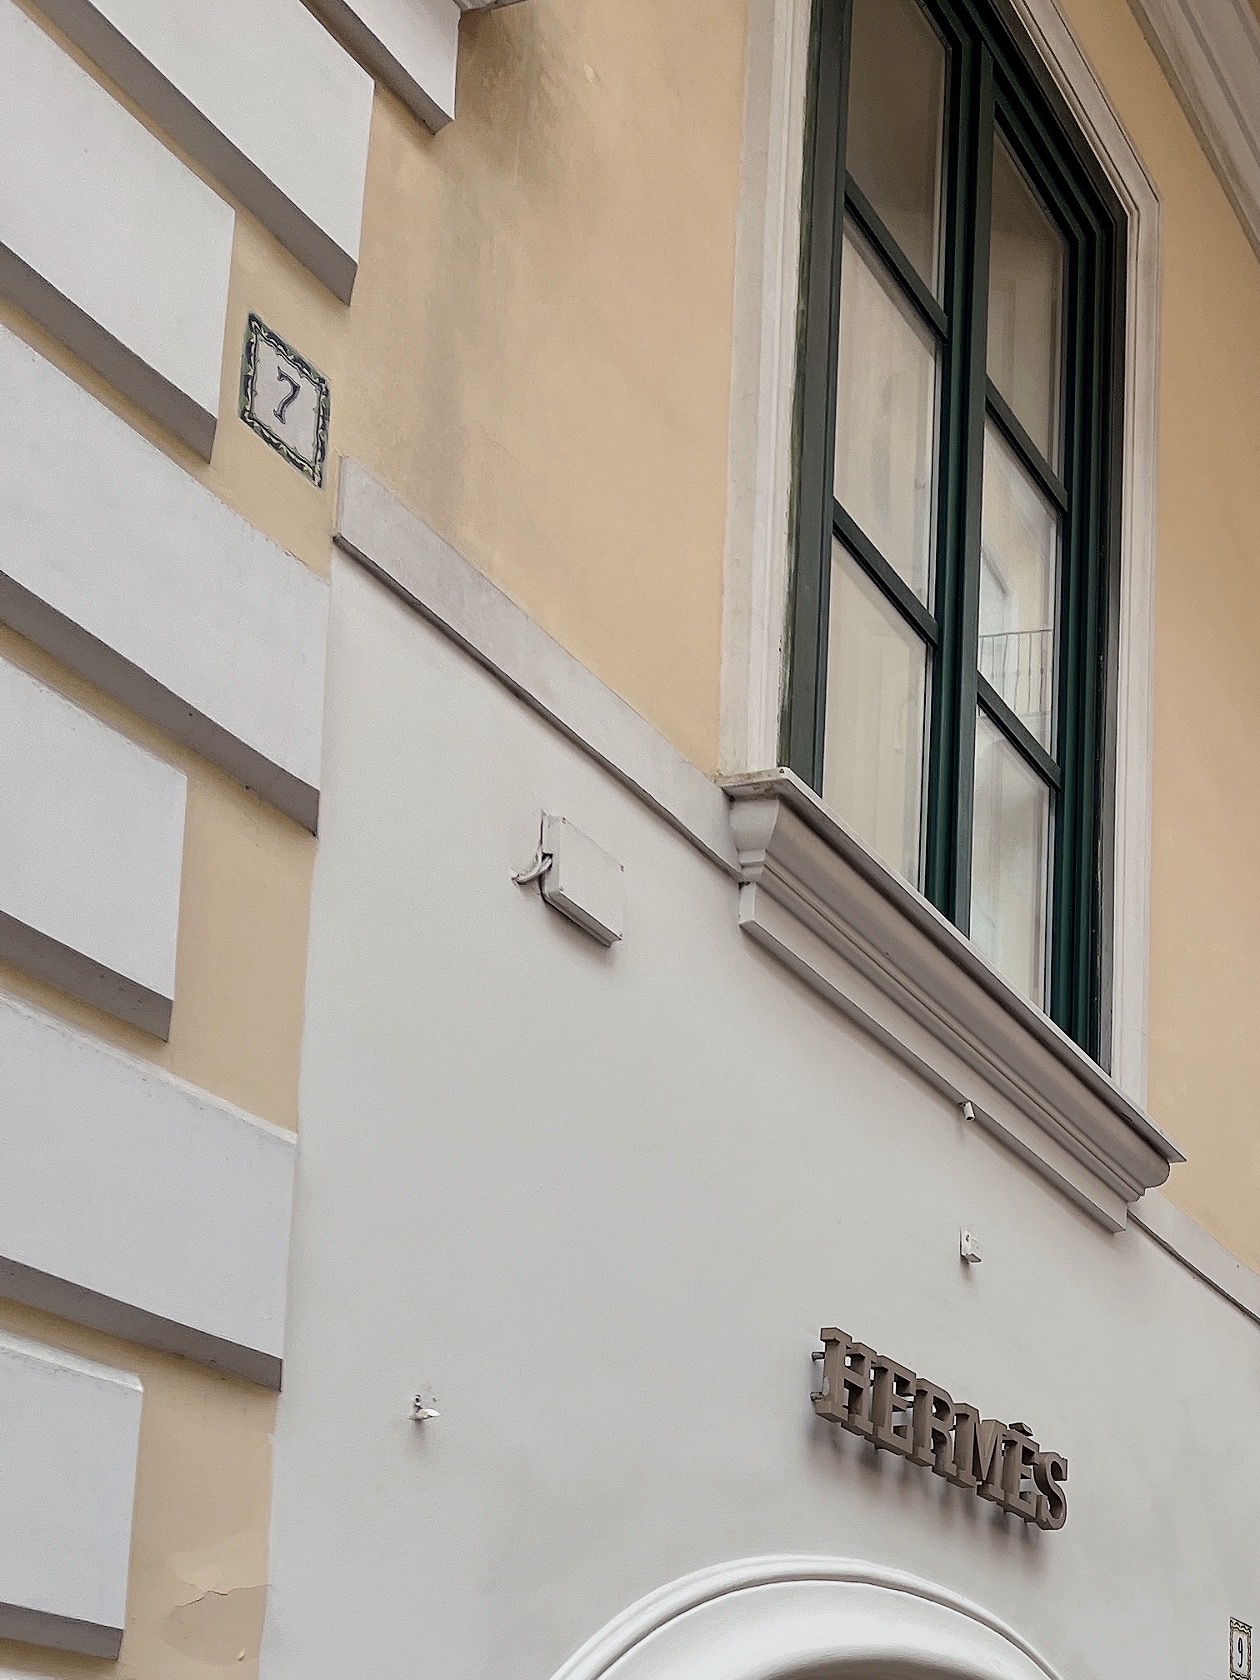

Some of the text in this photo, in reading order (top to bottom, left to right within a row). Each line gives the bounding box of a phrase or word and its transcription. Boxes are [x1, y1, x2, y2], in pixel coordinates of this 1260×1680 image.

[272, 365, 301, 425] 7
[815, 1327, 1068, 1530] HERMÈS
[1237, 1637, 1244, 1669] 9
